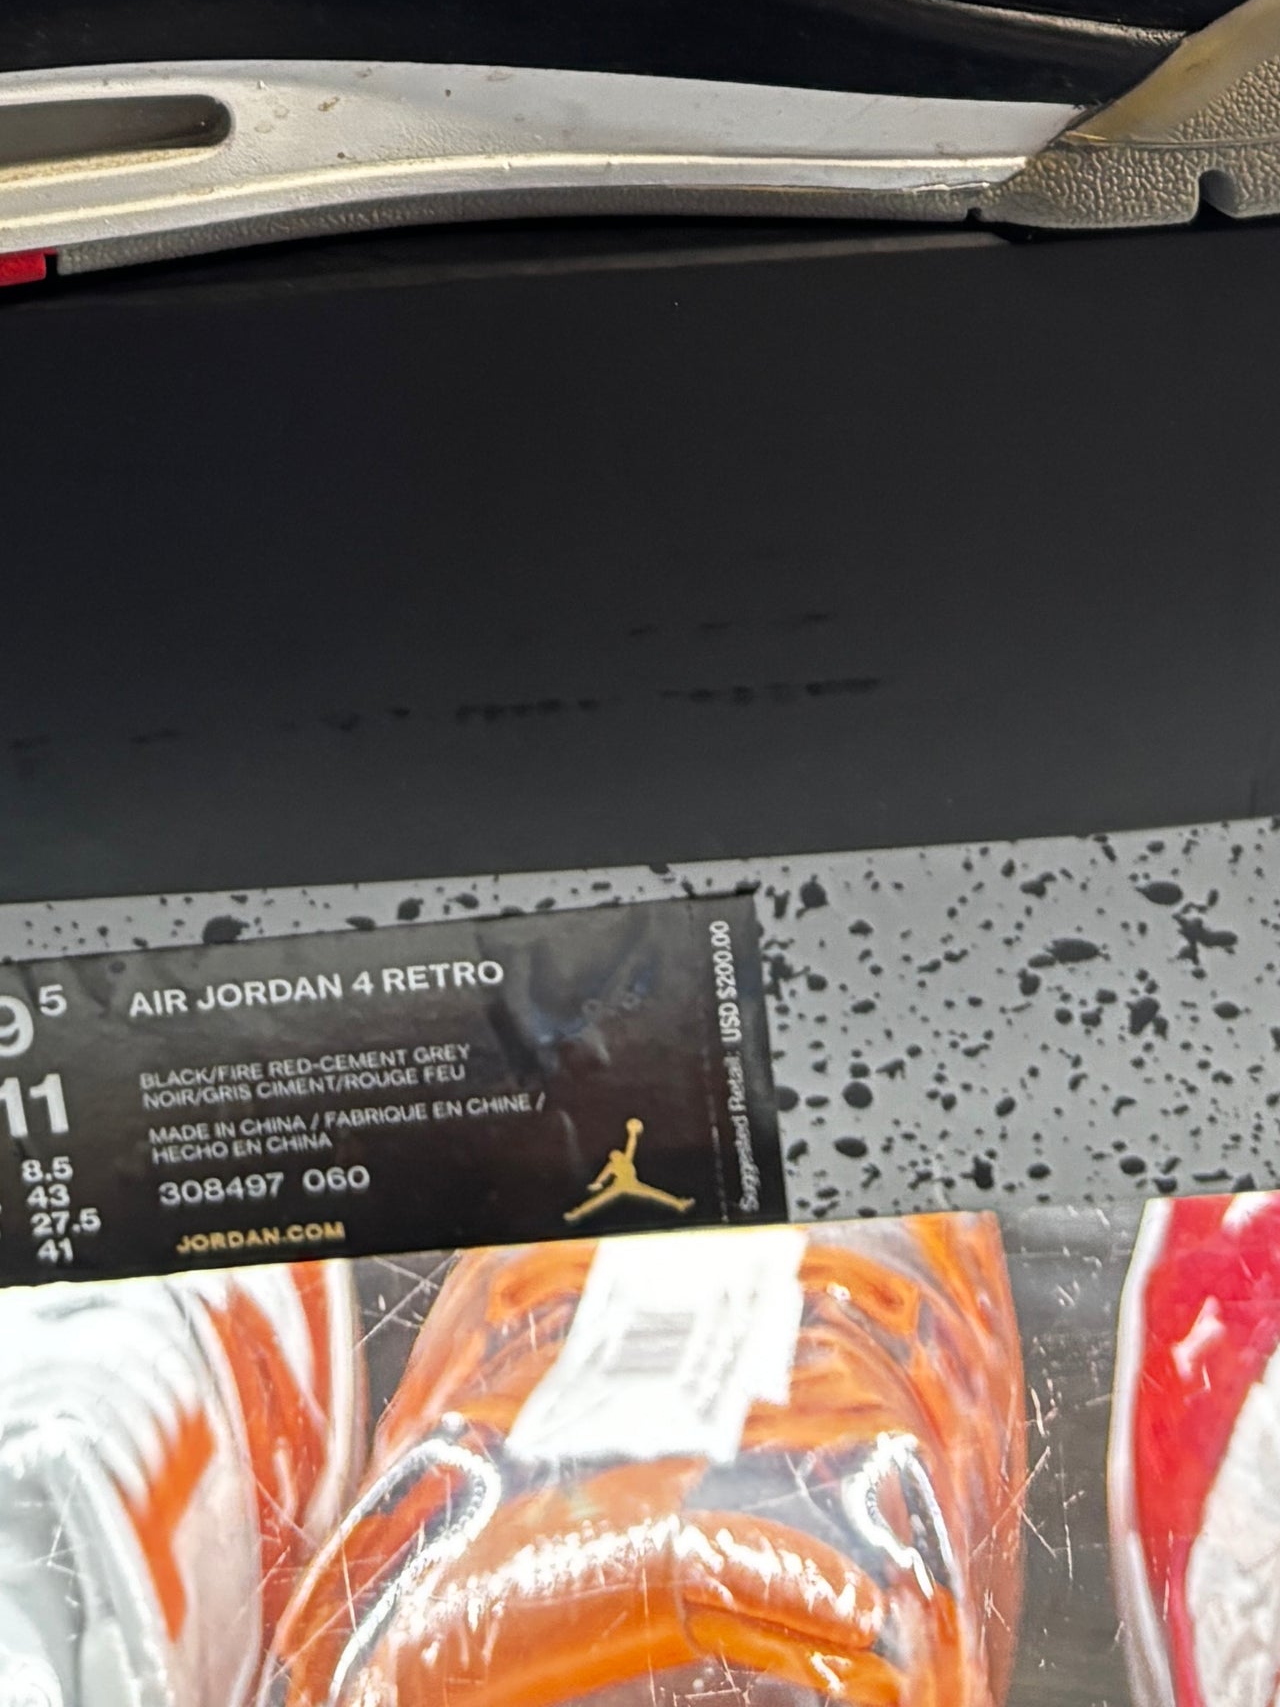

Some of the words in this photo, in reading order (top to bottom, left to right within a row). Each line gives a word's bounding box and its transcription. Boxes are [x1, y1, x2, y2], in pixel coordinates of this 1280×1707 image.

[710, 921, 738, 1001] $200.00
[129, 988, 188, 1018] AIR
[197, 974, 343, 1011] JORDAN
[352, 973, 374, 996] 4
[382, 960, 505, 993] RETRO
[718, 1002, 742, 1044] USD
[140, 1060, 263, 1091] BLACK/FIRE
[269, 1047, 407, 1078] RED-CEMENT
[413, 1043, 471, 1064] GREY
[142, 1084, 252, 1111] NOIR/GRIS
[256, 1069, 418, 1098] CIMENT/ROUGE
[423, 1065, 466, 1083] FEU
[149, 1124, 209, 1145] MADE
[215, 1120, 236, 1138] IN
[240, 1114, 307, 1136] CHINA
[324, 1103, 428, 1129] FABRIQUE
[433, 1100, 463, 1117] EN
[466, 1094, 532, 1115] CHINE
[151, 1140, 228, 1165] HECHO
[233, 1136, 263, 1157] EN
[266, 1131, 334, 1154] CHINA
[730, 1115, 761, 1212] Suggested
[22, 1156, 73, 1183] 8.5
[158, 1171, 285, 1207] 308497
[301, 1164, 371, 1193] 060
[27, 1184, 70, 1209] 43
[30, 1208, 101, 1236] 27.5
[176, 1221, 346, 1254] JORDAN.COM
[37, 1238, 73, 1263] 41
